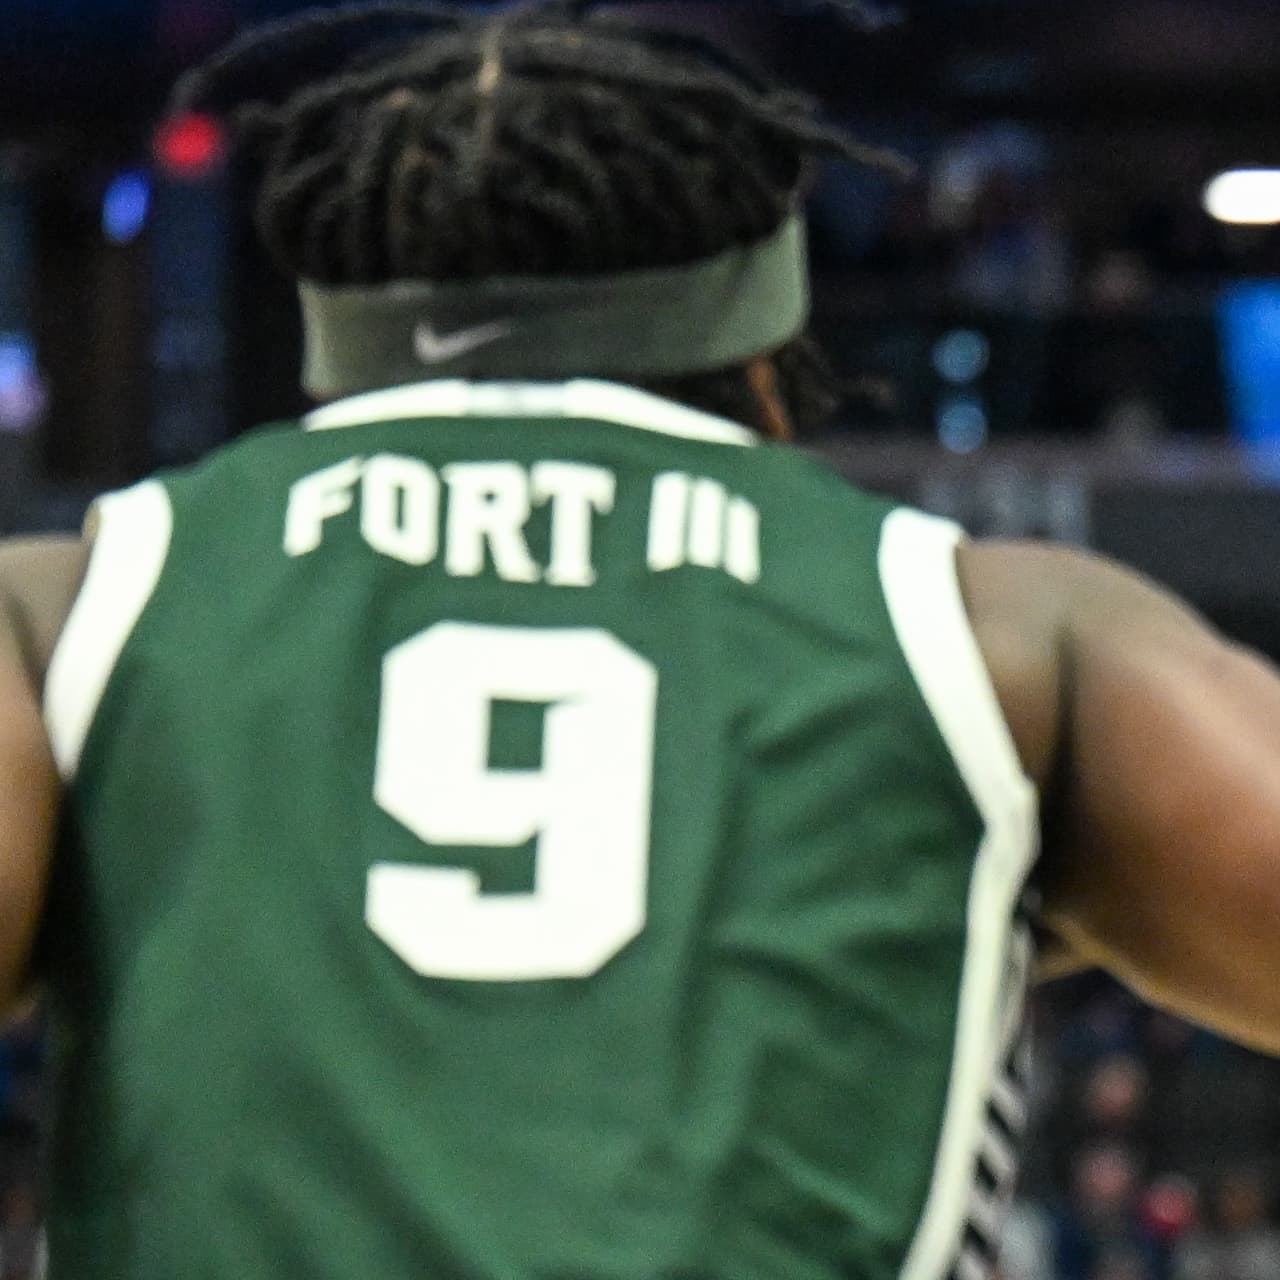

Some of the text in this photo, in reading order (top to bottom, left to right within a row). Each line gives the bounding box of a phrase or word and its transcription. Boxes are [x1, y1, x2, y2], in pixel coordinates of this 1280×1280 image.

[283, 453, 760, 586] FORT III
[365, 621, 657, 981] 9
